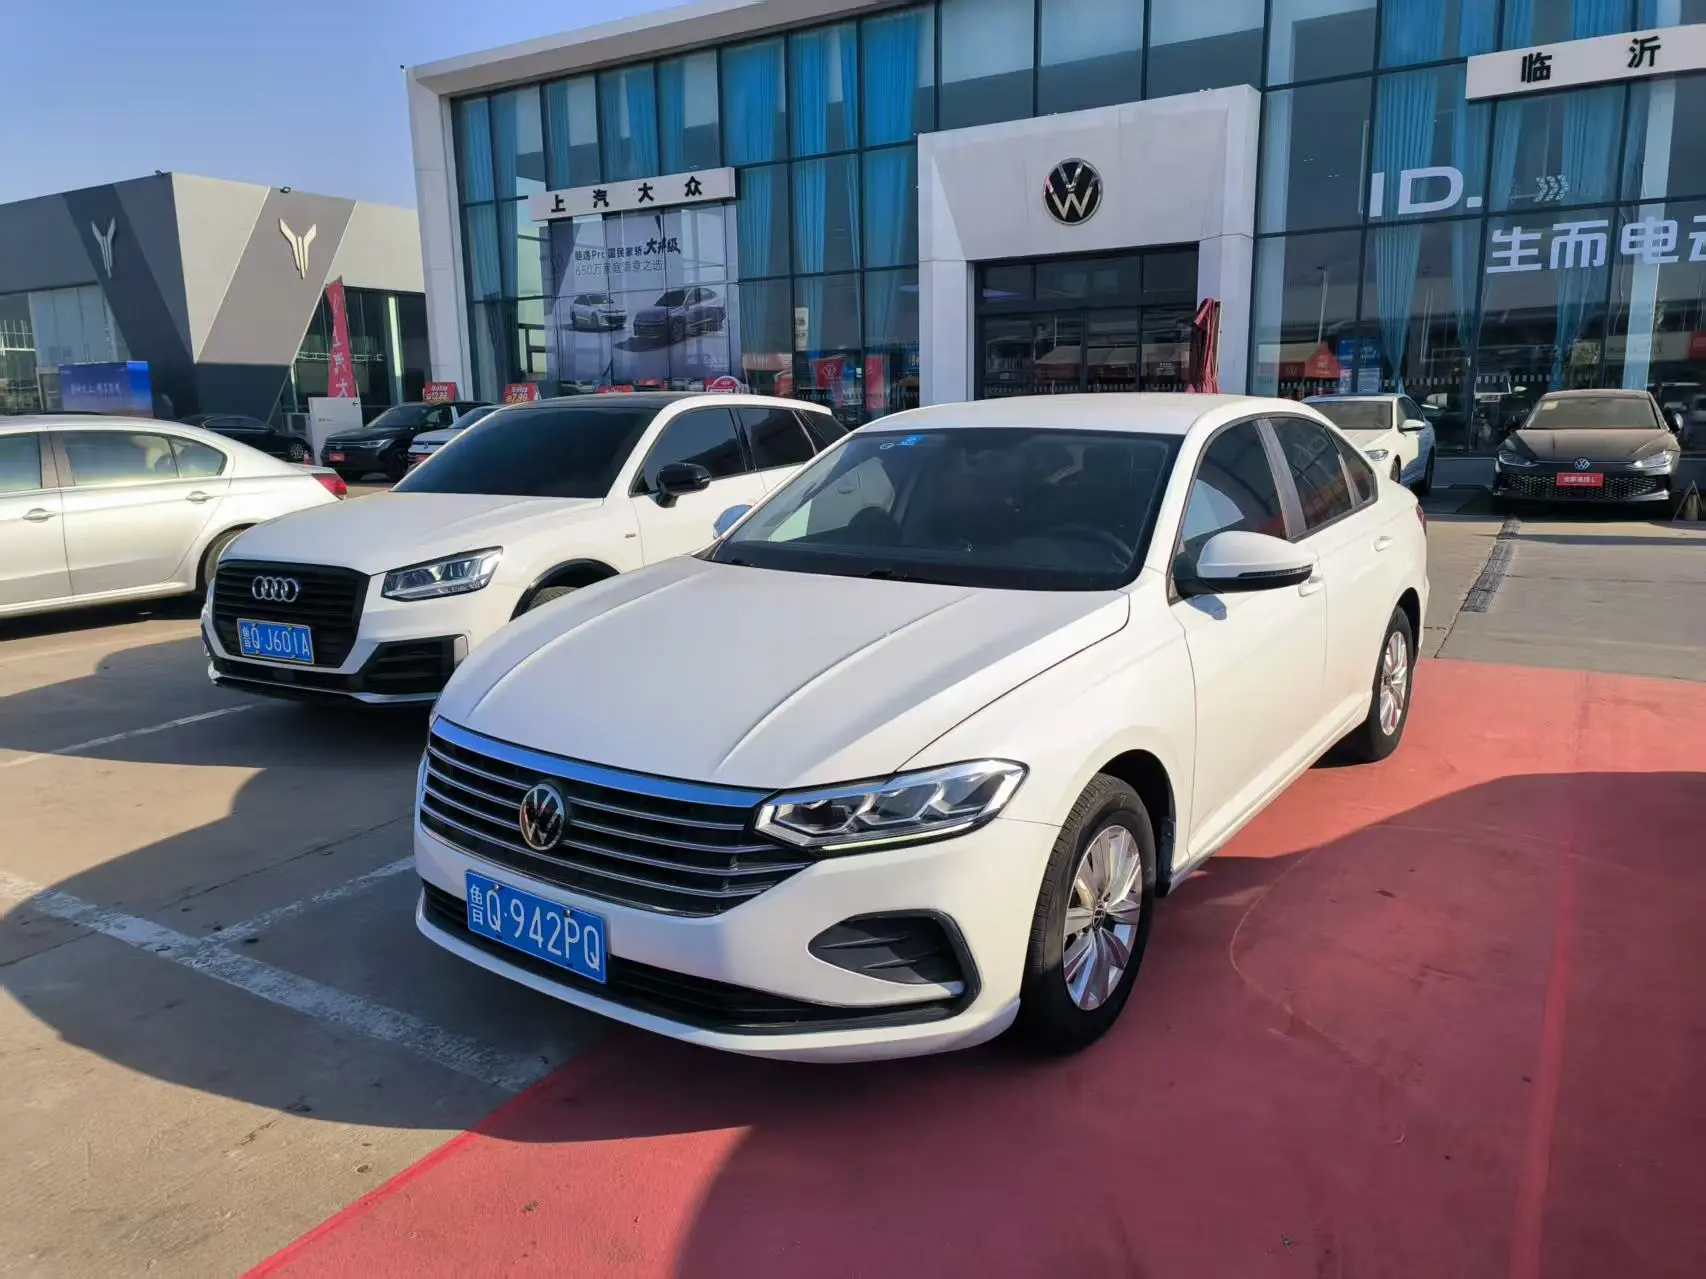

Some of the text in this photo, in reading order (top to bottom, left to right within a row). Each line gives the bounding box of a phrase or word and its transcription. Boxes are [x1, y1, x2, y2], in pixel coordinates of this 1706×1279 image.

[1520, 35, 1661, 83] 临沂
[551, 175, 703, 213] 上汽大众
[1369, 166, 1483, 218] ID.
[470, 883, 600, 971] 鲁Q·942PQ
